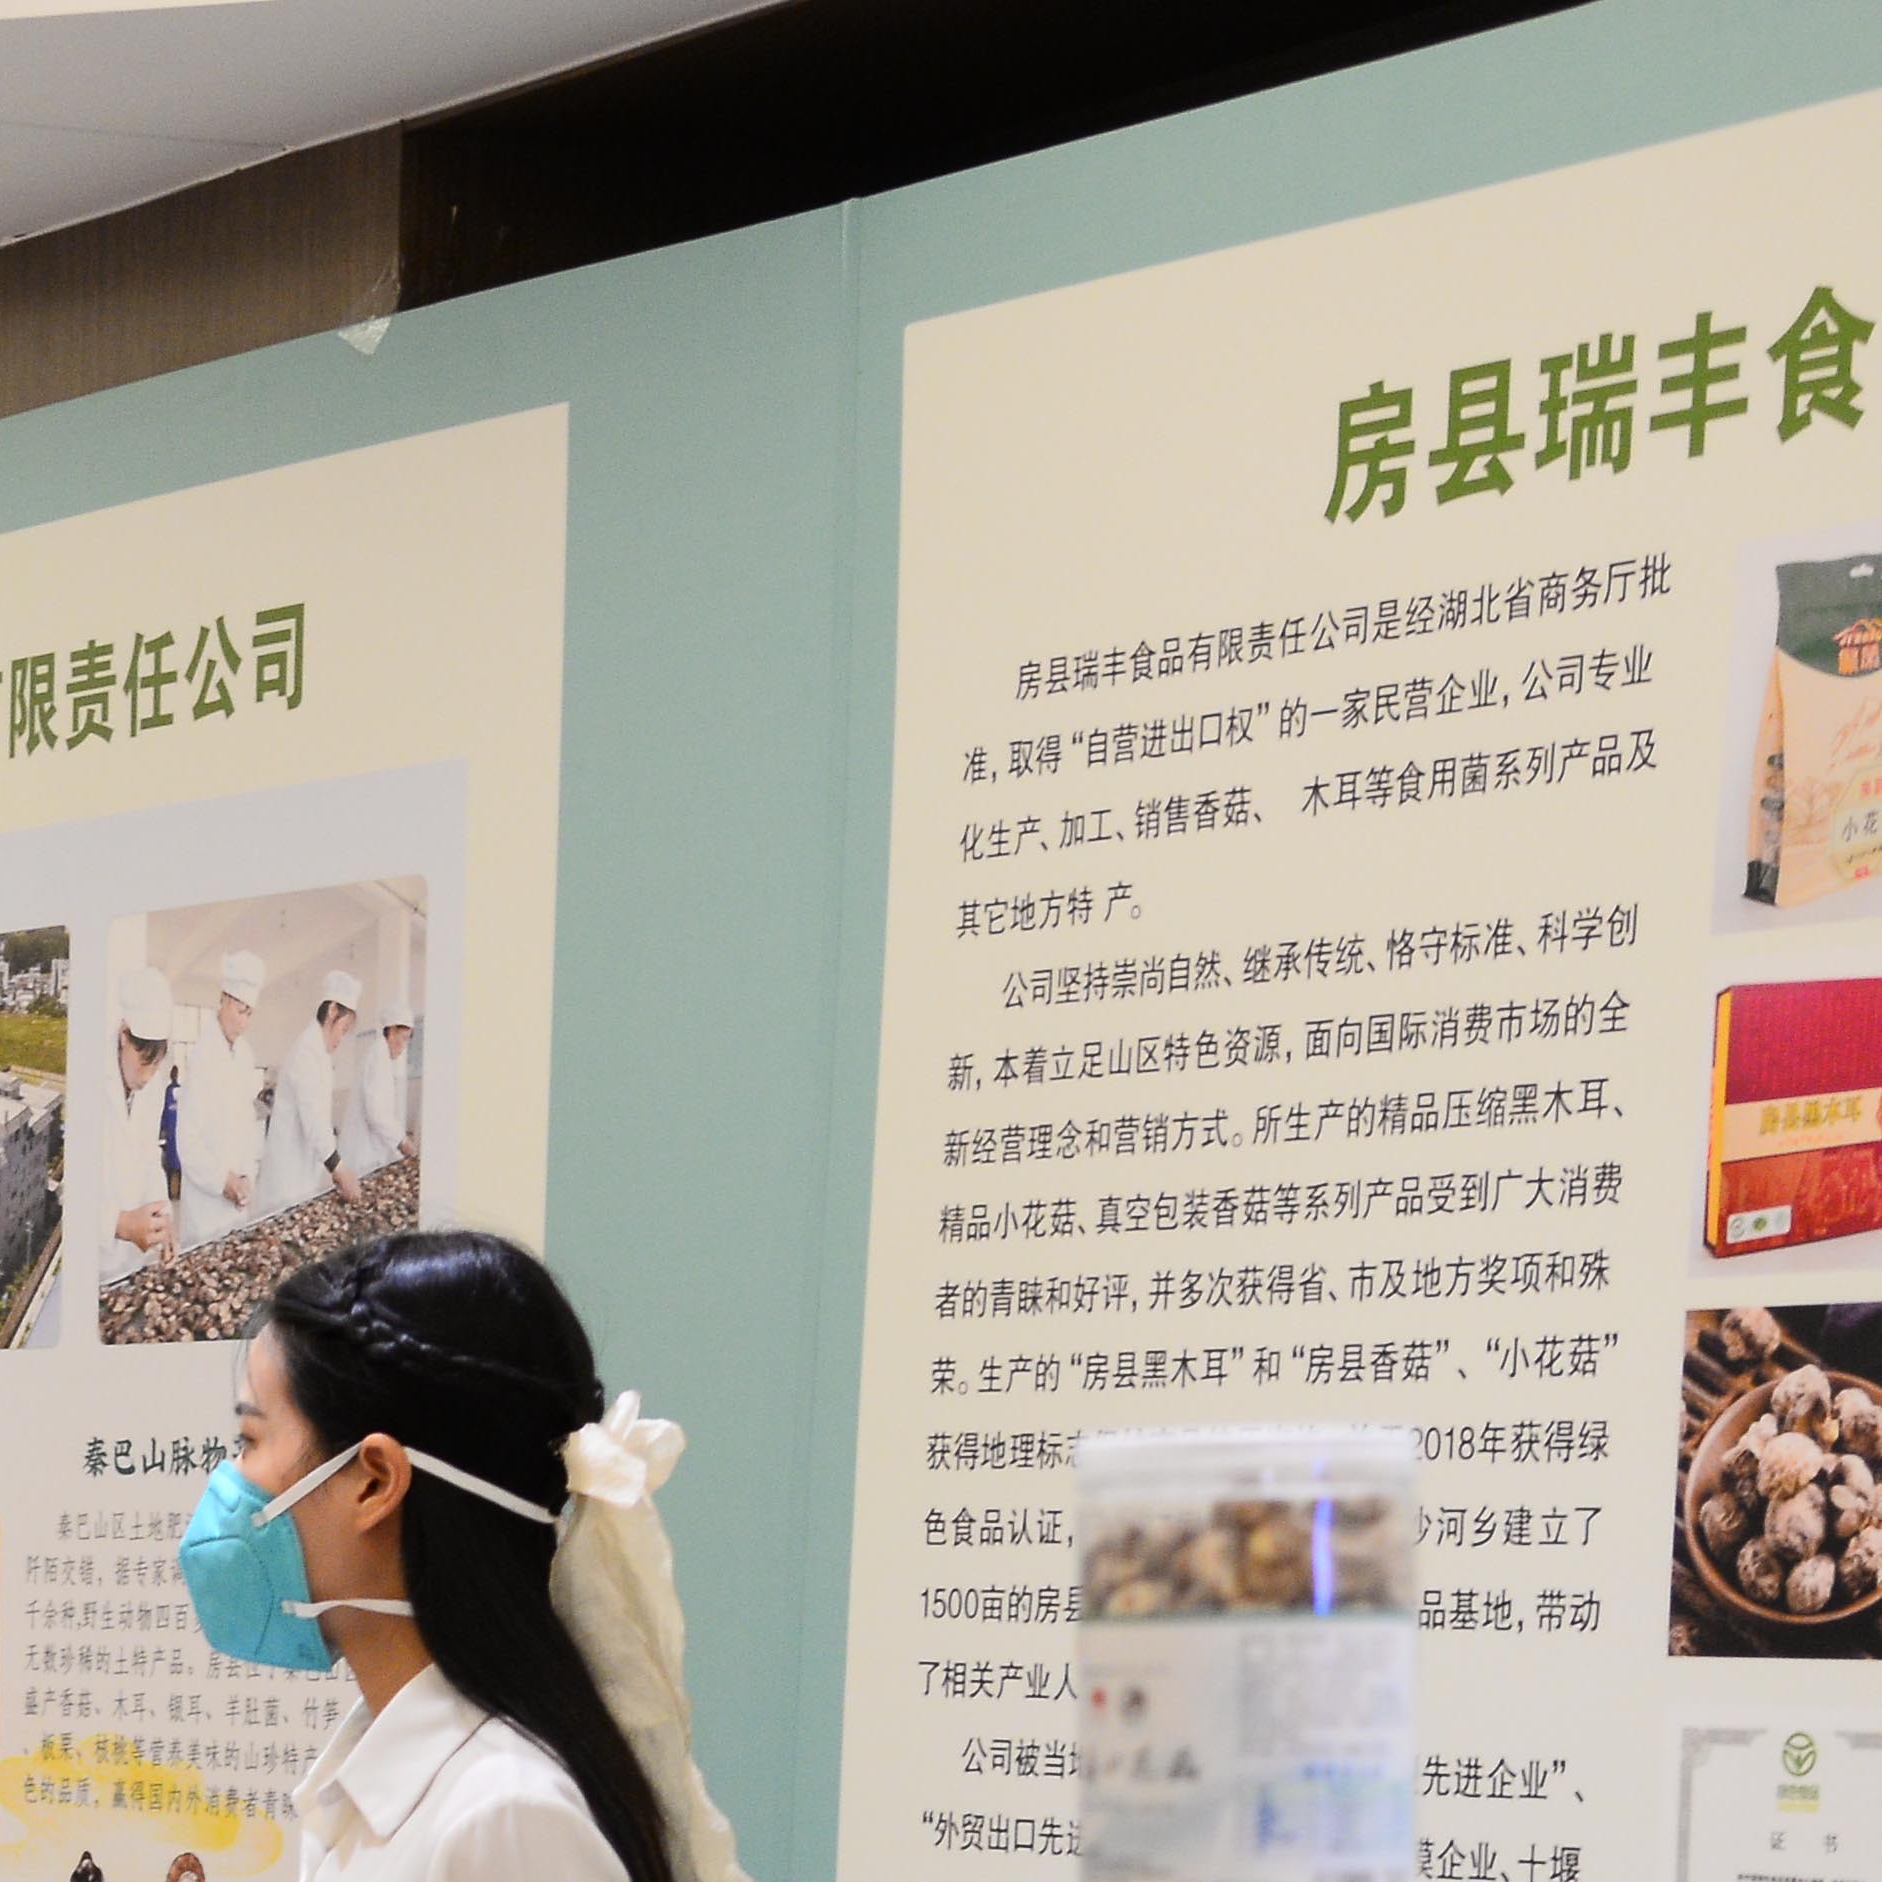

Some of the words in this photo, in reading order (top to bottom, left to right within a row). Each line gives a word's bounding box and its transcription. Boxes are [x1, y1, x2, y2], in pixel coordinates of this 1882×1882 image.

[1323, 284, 1876, 525] 房县瑞丰食
[1015, 551, 1671, 701] 房县瑞丰食品有限责任公司是经湖北省商务厅批
[1002, 903, 1638, 1009] 公司坚持崇尚自然、继承传统、恪守标准、科学创
[943, 1077, 1628, 1167] 新经营理念和营销方式。所生产的精品压缩黑木耳、
[938, 1161, 1623, 1243] 精品小花菇、真空包装香菇等系列产品受到广大消费
[935, 1248, 1610, 1319] 者的青睐和好评，并多次获得省、市及地方奖项和殊
[83, 1431, 247, 1477] 秦巴山脉物
[57, 1511, 190, 1542] 秦巴山区土地肥
[1418, 1589, 1601, 1633] 品基地，带动
[918, 1660, 1077, 1701] 了相关产业人
[1417, 1755, 1584, 1803] 先进企业”、
